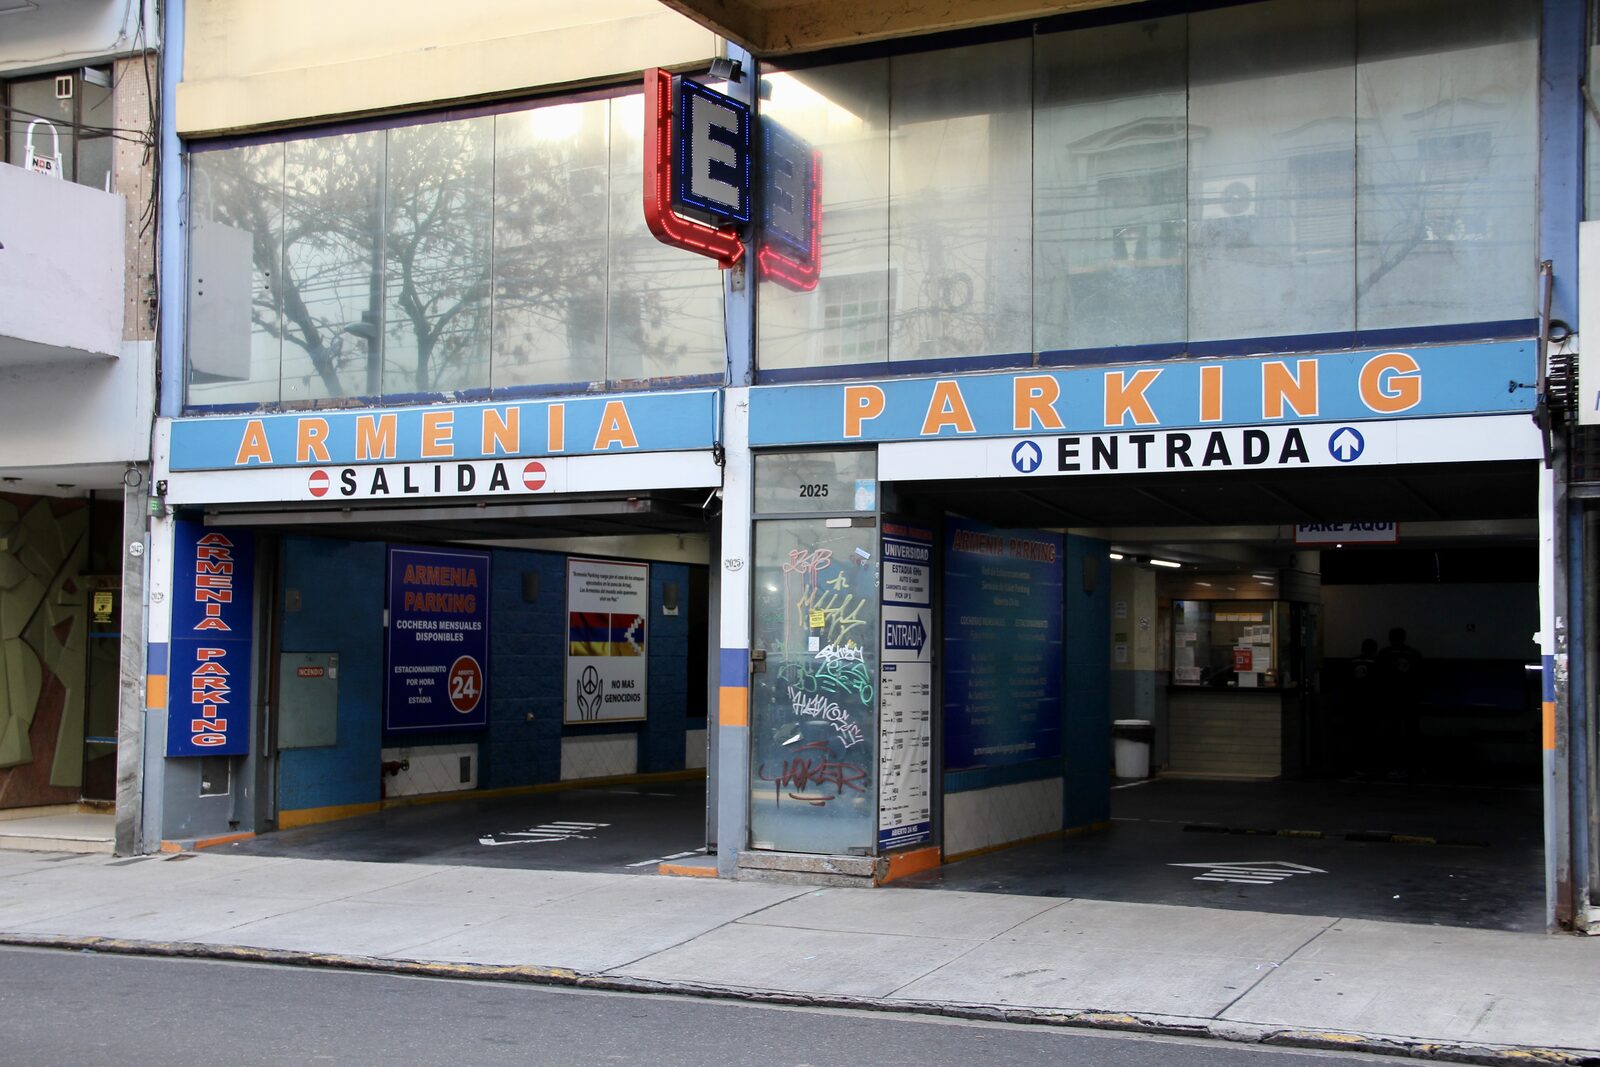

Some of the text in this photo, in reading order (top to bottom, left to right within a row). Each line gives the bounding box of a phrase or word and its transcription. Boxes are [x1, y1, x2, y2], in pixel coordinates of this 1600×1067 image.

[691, 93, 740, 211] E
[842, 351, 1423, 439] PARKING
[235, 401, 639, 465] ARMENIA
[1056, 427, 1311, 472] ENTRADA
[340, 462, 511, 496] SALIDA
[800, 484, 829, 497] 2025
[884, 543, 929, 561] UNIVERSIDAD
[952, 528, 1057, 564] ARMENIA PARKING
[403, 564, 477, 587] ARMENIA
[892, 564, 912, 576] ESTADIA
[404, 591, 477, 613] PARKING
[396, 619, 482, 631] COCHERAS MENSUALES
[191, 532, 235, 747] ARMENIA PARKING
[415, 632, 464, 642] DISPONIBLES
[886, 624, 922, 647] ENTRADA
[394, 665, 447, 674] ESTACIONAMIENTO
[406, 678, 435, 686] POR HORA
[452, 676, 475, 699] 24
[611, 679, 635, 689] NO MAS
[408, 696, 432, 704] ESTADIA
[604, 693, 641, 703] GENOCIDIOS
[891, 826, 907, 837] ABIERTO
